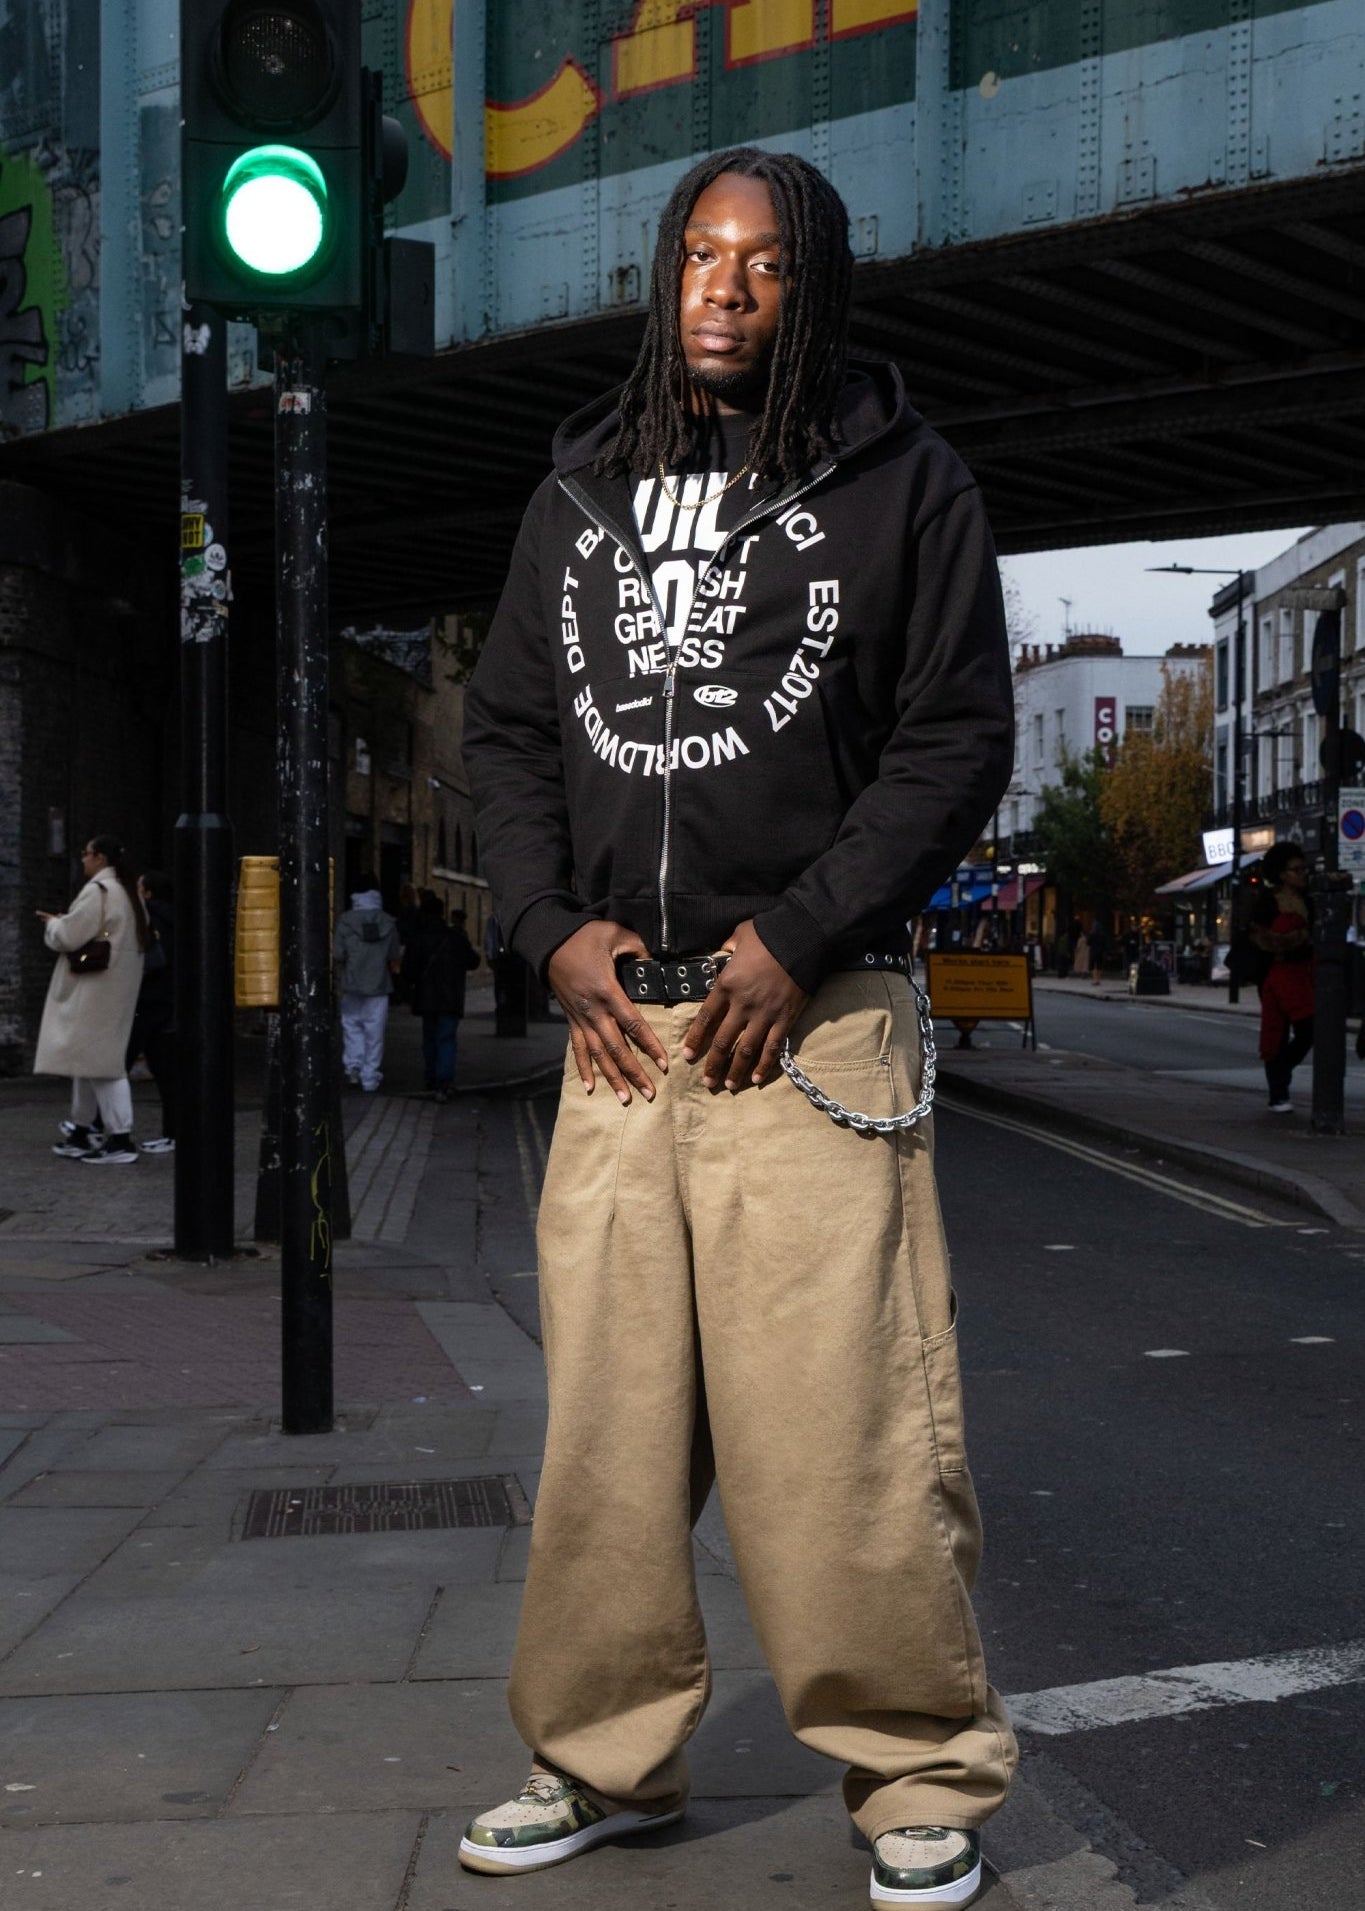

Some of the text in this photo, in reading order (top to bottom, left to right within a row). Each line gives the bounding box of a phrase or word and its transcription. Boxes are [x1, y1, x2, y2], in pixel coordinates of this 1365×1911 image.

[561, 567, 586, 674] DEPT
[614, 605, 747, 645] GREAT
[628, 639, 726, 679] NESS
[763, 579, 841, 733] EST.2017
[574, 683, 750, 778] WORLDWIDE
